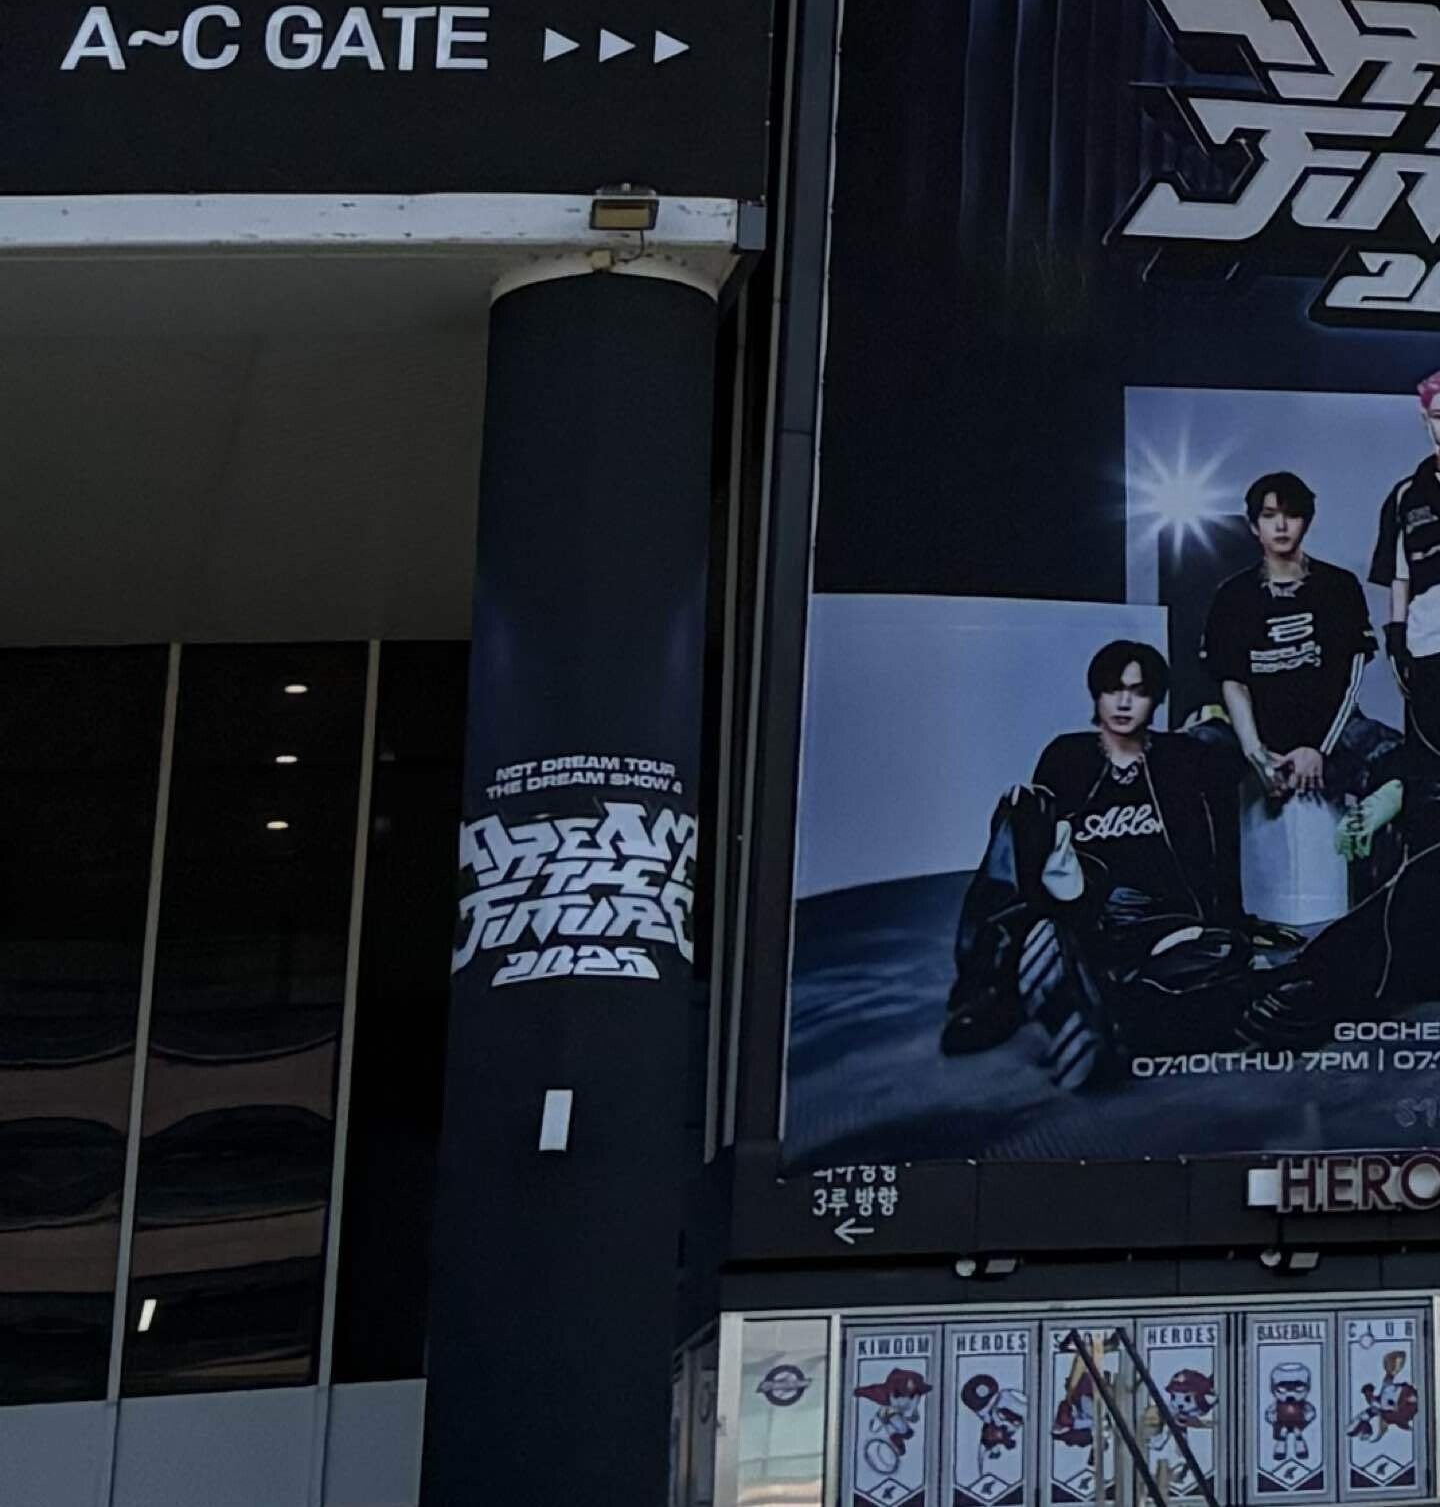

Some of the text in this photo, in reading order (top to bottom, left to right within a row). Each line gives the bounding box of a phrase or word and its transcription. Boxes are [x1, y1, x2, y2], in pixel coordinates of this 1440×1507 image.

[60, 5, 490, 71] A~C GATE
[542, 756, 620, 773] DREAM
[624, 757, 675, 777] TOUR
[486, 780, 522, 799] THE
[526, 771, 605, 791] DREAM
[610, 773, 670, 793] SHOW
[540, 859, 668, 896] THE
[492, 946, 659, 987] 2025
[1301, 1051, 1369, 1071] 7PM
[812, 1185, 898, 1216] 3루 방향
[858, 1336, 930, 1354] KIWOOM
[1147, 1327, 1215, 1344] HEROES
[1257, 1324, 1322, 1340] BASEBALL
